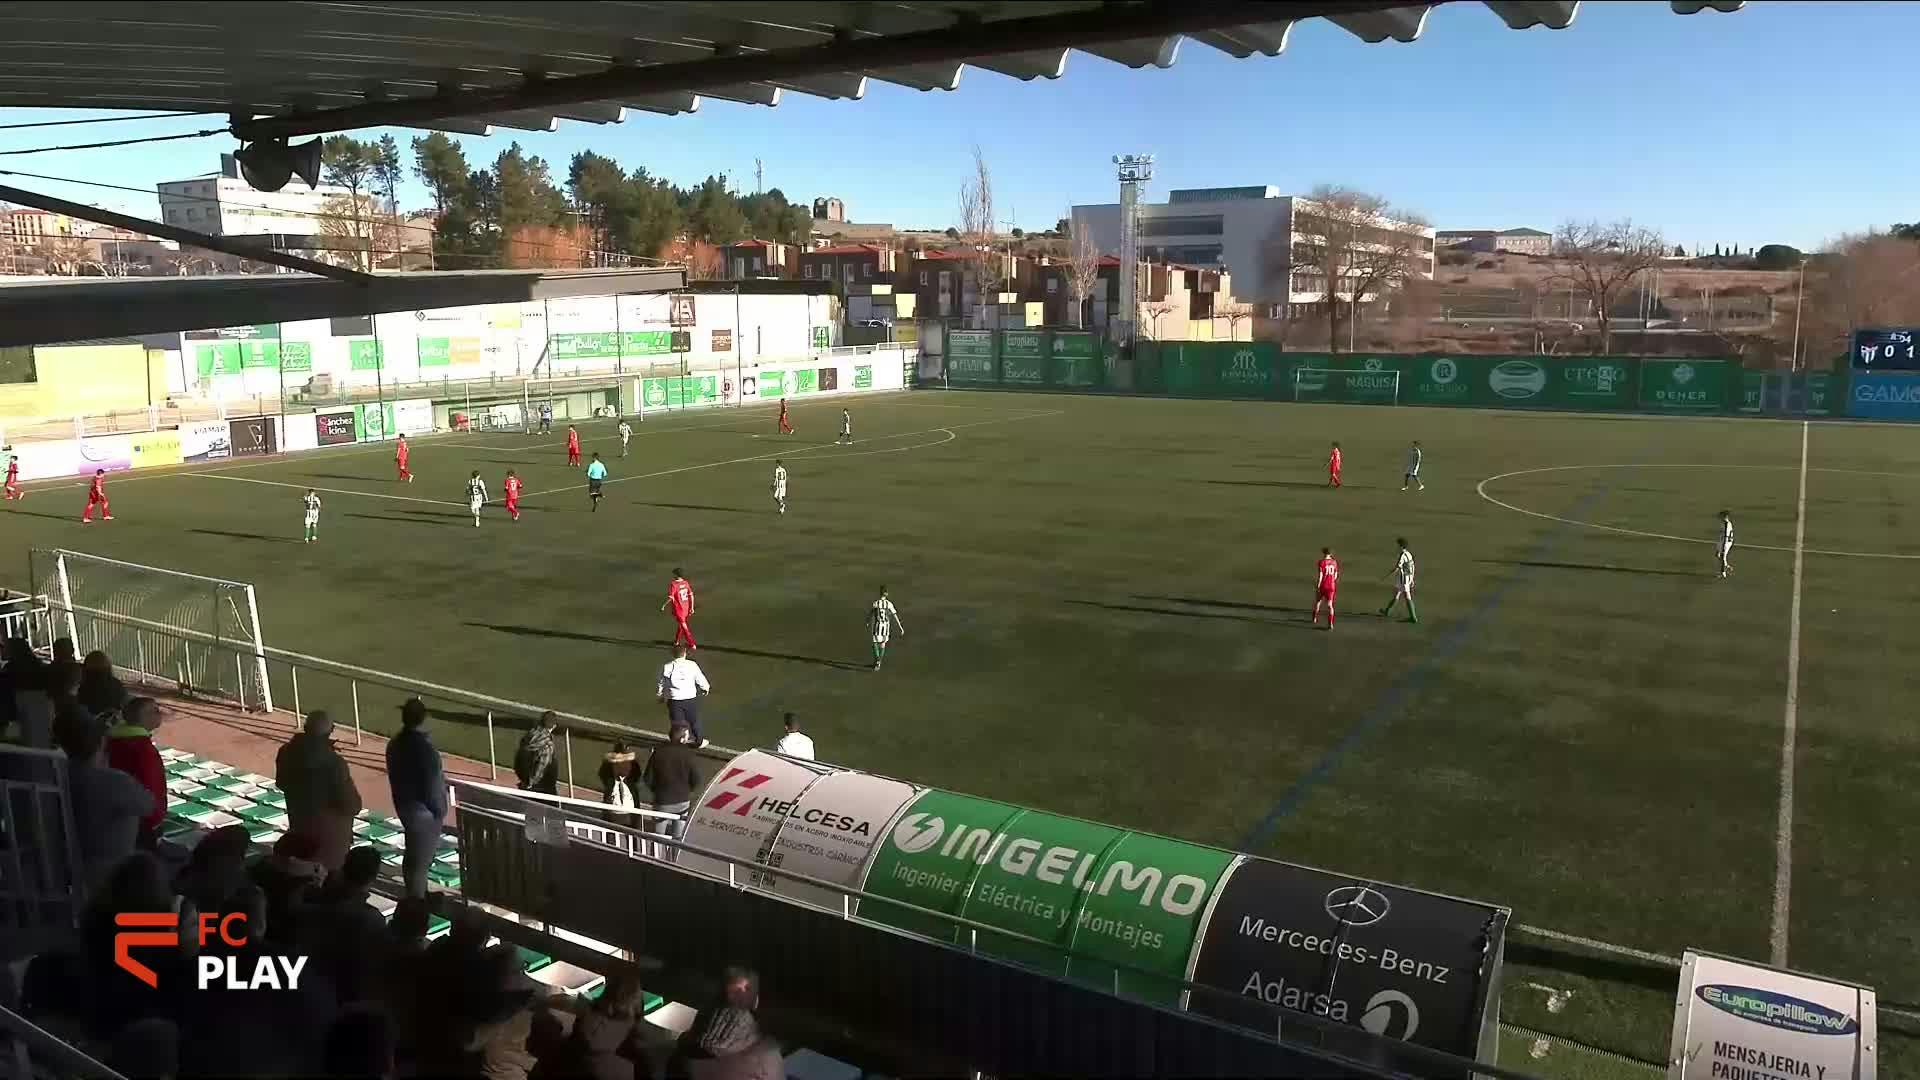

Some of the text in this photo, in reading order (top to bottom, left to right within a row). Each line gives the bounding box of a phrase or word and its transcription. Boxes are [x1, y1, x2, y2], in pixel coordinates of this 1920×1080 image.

[1885, 346, 1914, 358] 0 1
[1325, 564, 1335, 576] 10
[752, 813, 793, 829] FABRICOS
[757, 797, 871, 836] HELCESA
[940, 823, 1207, 916] INGELMO
[892, 860, 1164, 949] Ingeniera Eléctrica y Montajes
[1238, 915, 1451, 984] Mercedes-Benz
[1241, 971, 1350, 1023] Adarsa
[1703, 986, 1850, 1030] Europillow
[1712, 1061, 1788, 1080] PAQUET
[1714, 1041, 1827, 1080] MENSAJERIA Y
